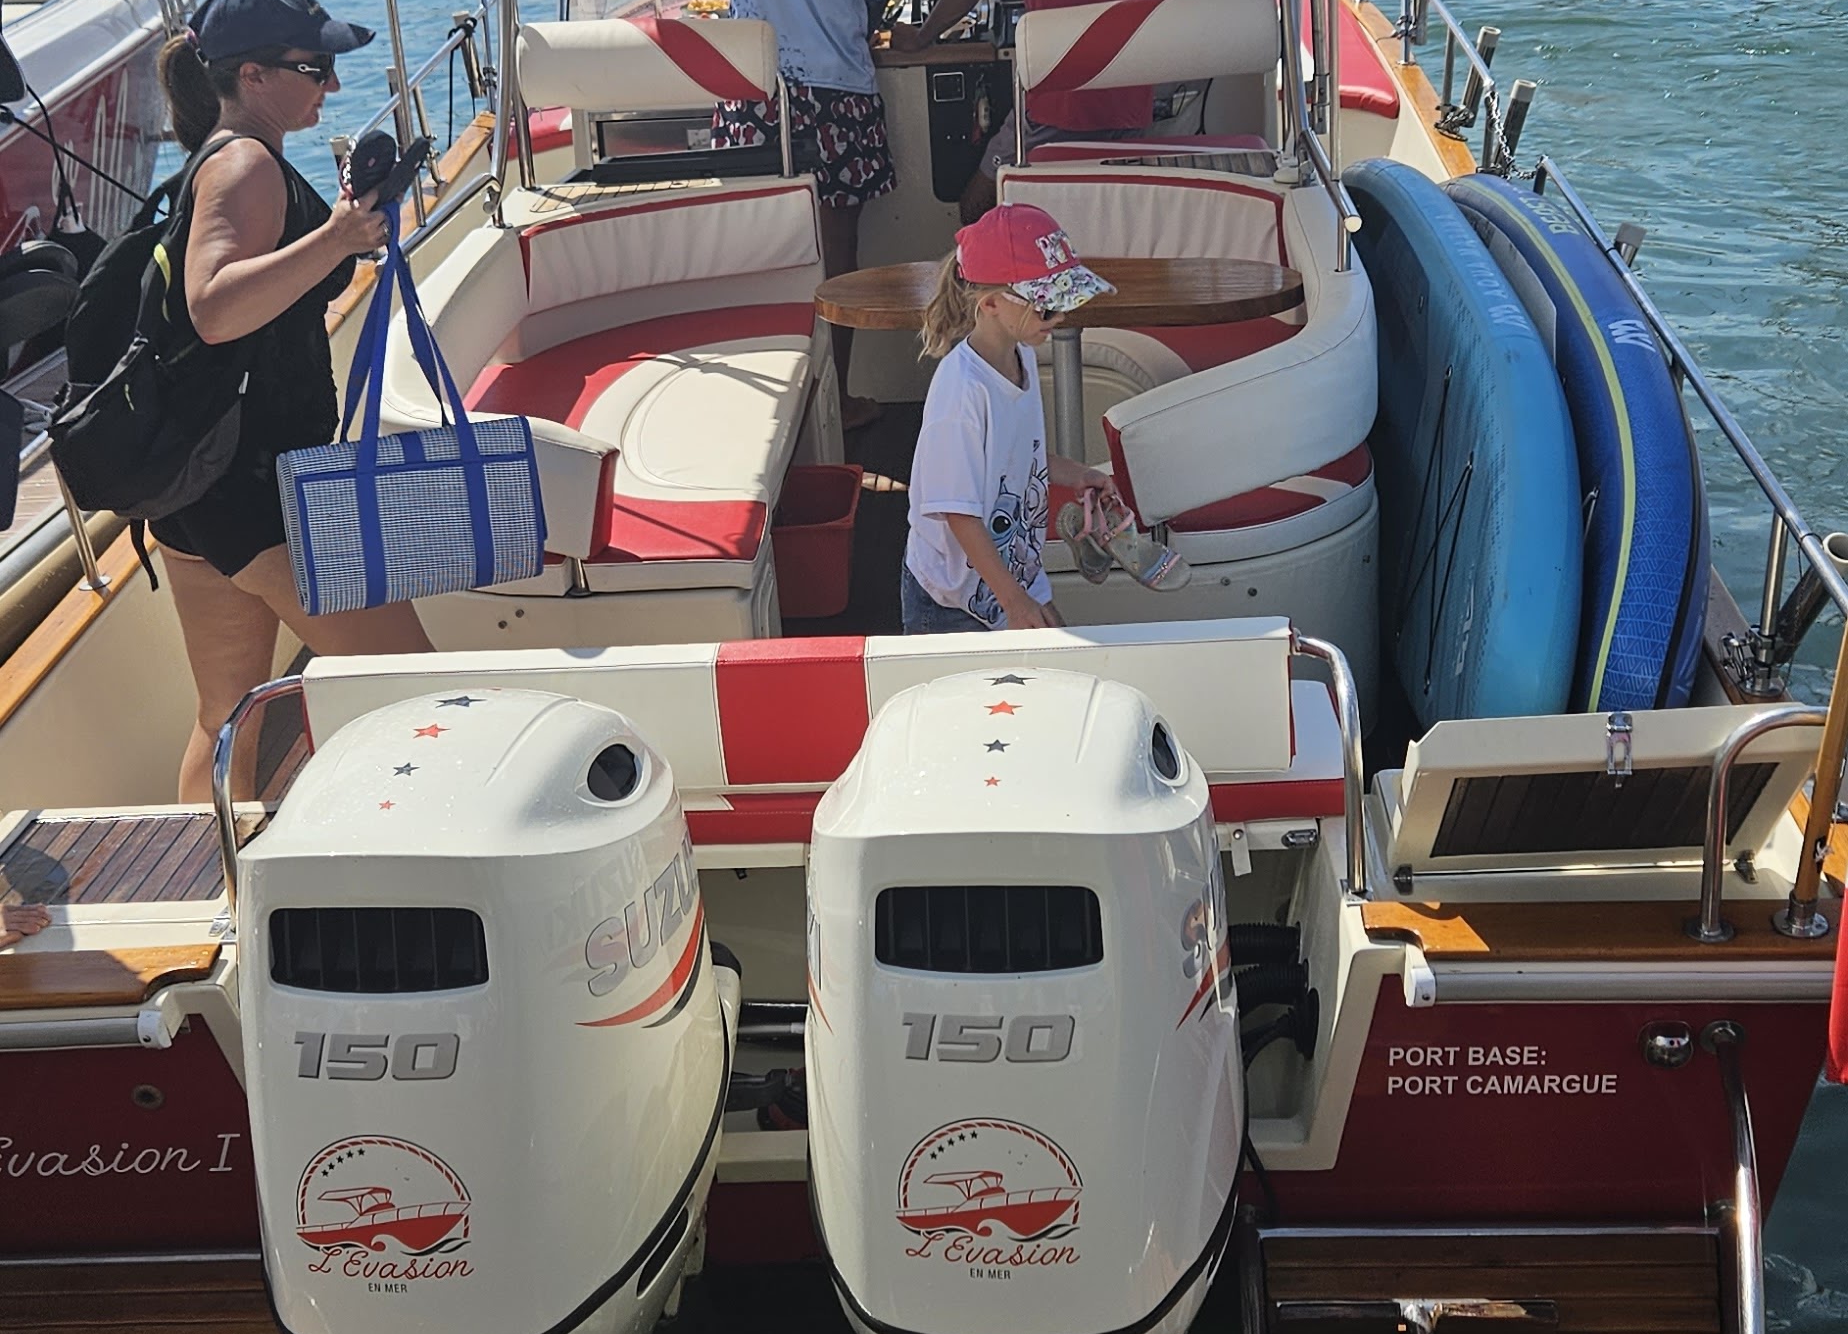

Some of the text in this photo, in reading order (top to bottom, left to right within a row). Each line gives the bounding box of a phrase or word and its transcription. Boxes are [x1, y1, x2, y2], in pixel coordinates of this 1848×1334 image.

[903, 1012, 1075, 1063] 150
[294, 1031, 461, 1081] 150
[1389, 1046, 1547, 1067] PORT BASE:
[1387, 1074, 1618, 1095] PORT CAMARGUE
[209, 1133, 241, 1172] I
[969, 1268, 1011, 1280] EN MER
[368, 1282, 408, 1294] EN MER
